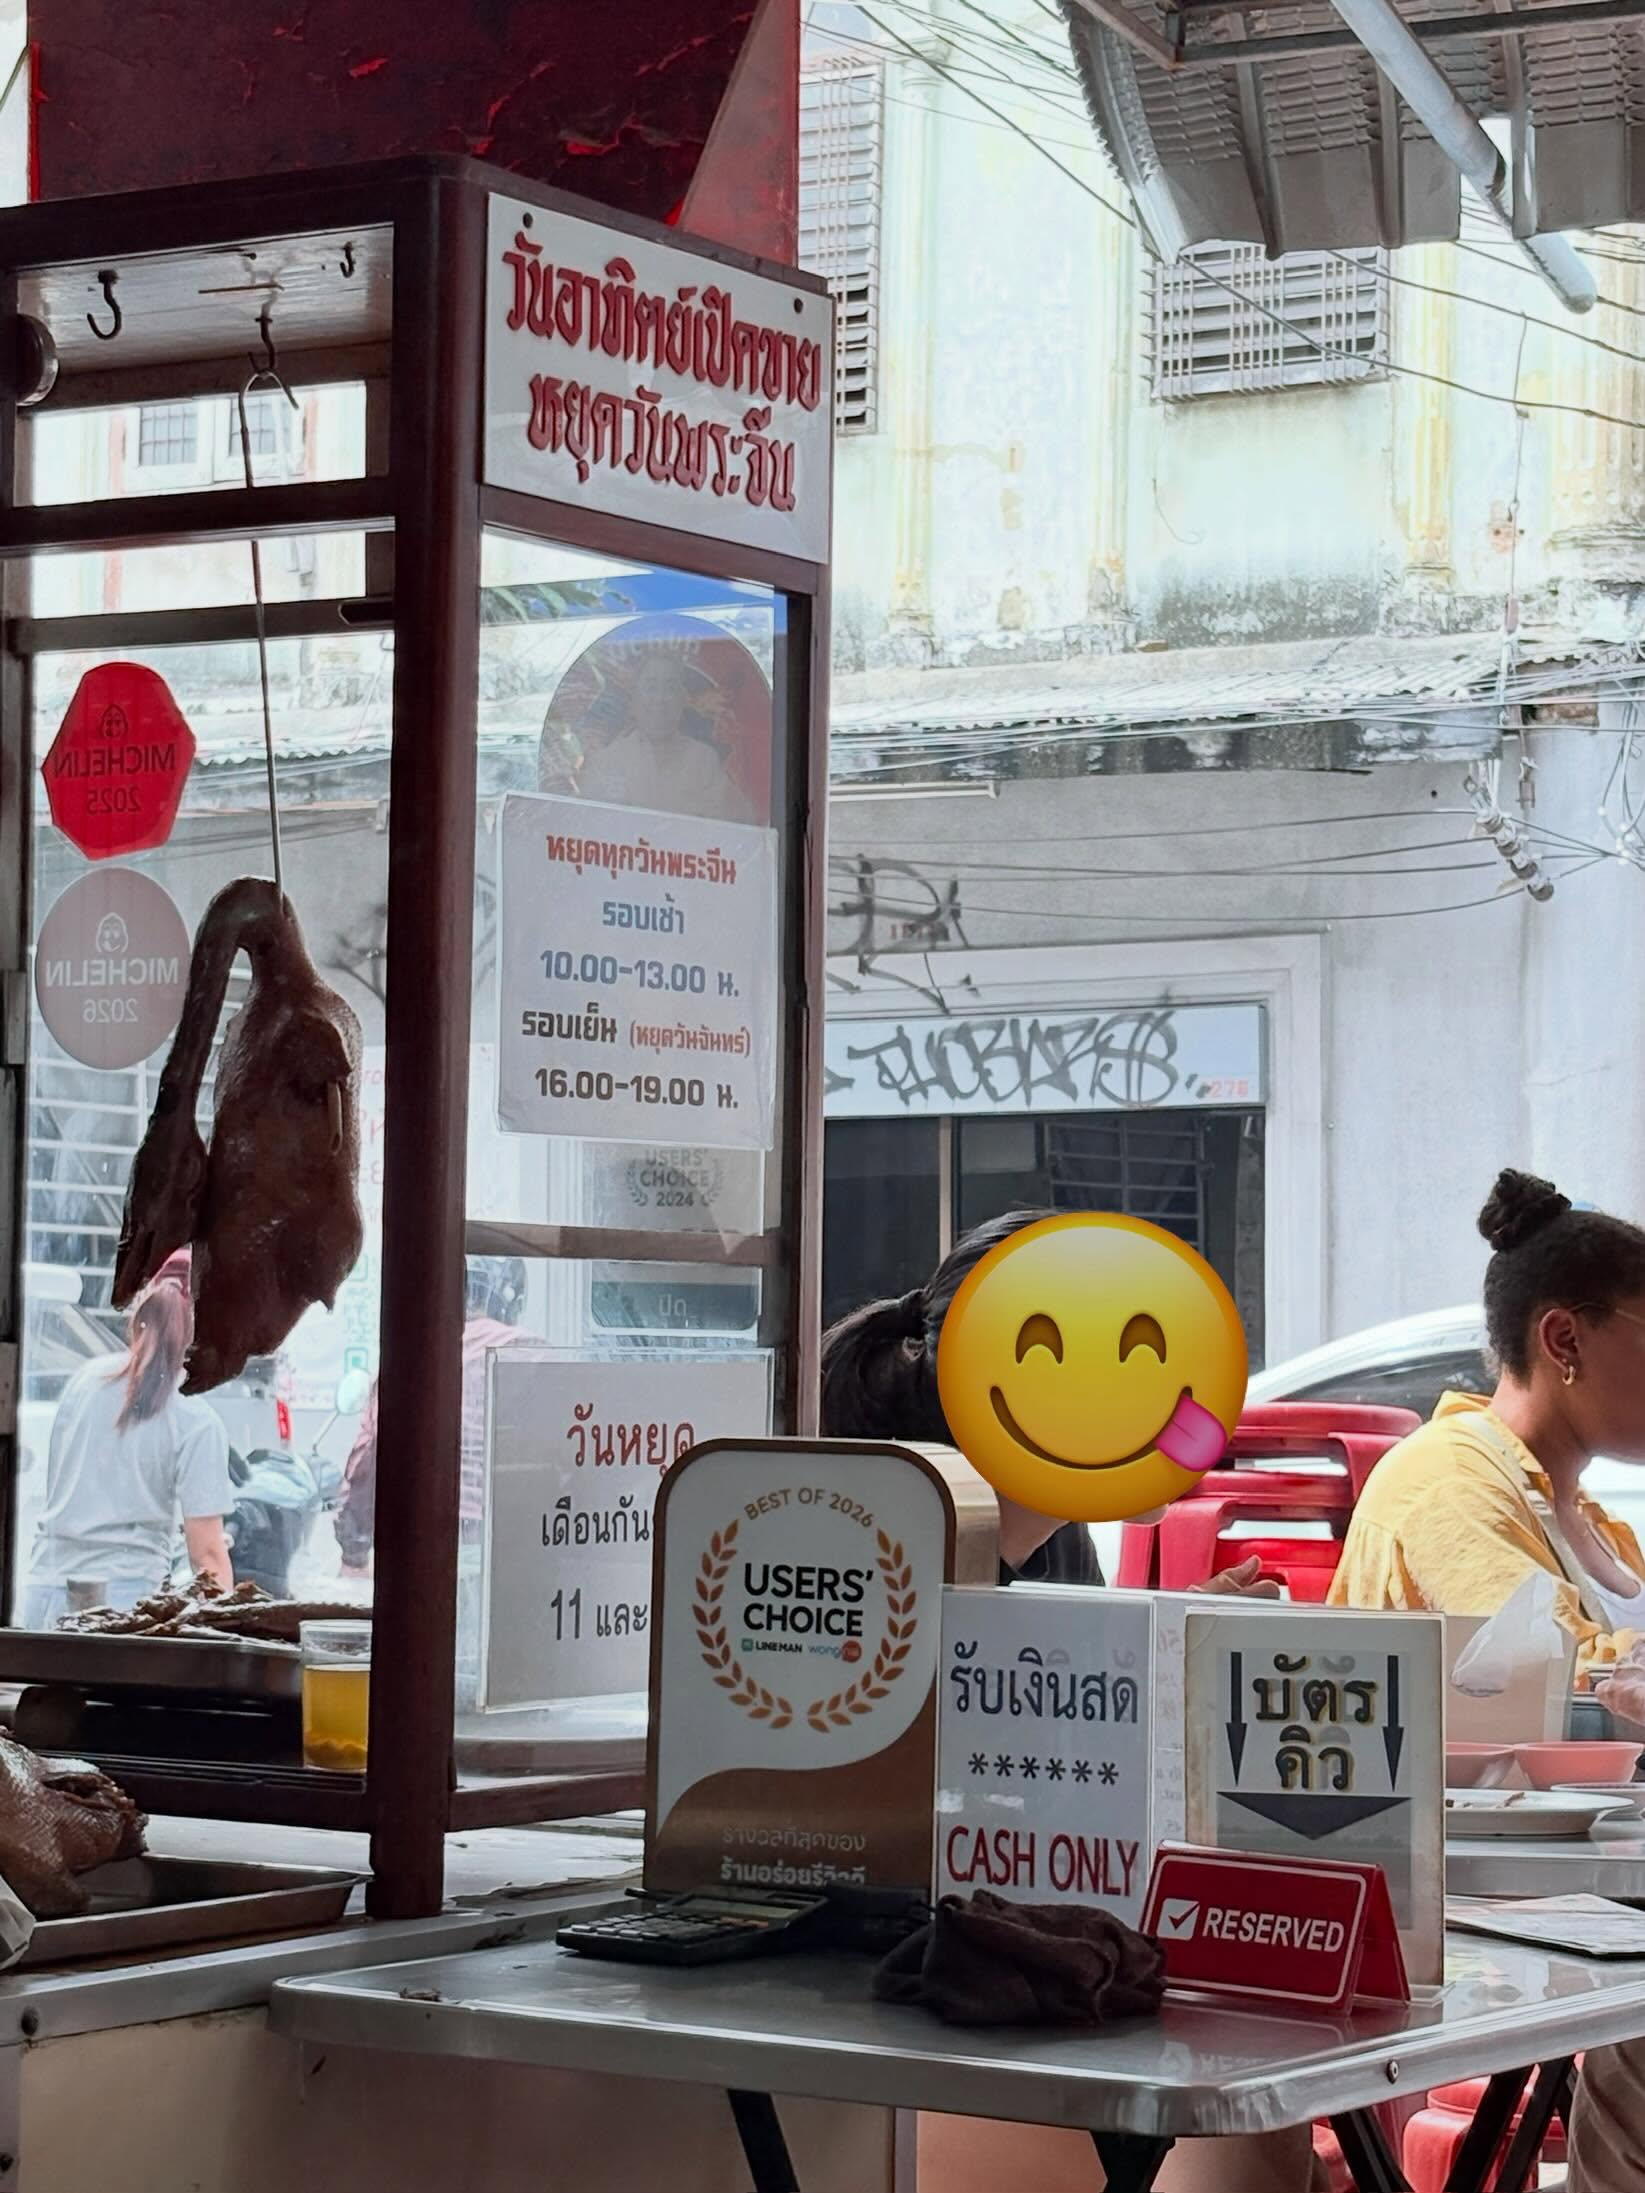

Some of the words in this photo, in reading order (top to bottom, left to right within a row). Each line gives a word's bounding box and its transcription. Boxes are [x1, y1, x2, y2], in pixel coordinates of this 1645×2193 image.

[502, 231, 821, 412] วันอาทิตย์เปิดขาย
[528, 373, 796, 511] หยุดวันพระจีน
[546, 834, 737, 885] หยุดทุกวันพระจีน
[602, 892, 685, 934] รอบเช้า
[540, 950, 706, 994] 10.00-13.00
[717, 971, 740, 997] น.
[522, 1002, 617, 1043] รอบเย็น
[630, 1019, 750, 1058] (หยุดวันจันทร์)
[535, 1067, 705, 1107] 16.00-19.00
[716, 1083, 739, 1109] น.
[639, 1169, 710, 1188] CHOICE
[655, 1191, 695, 1207] 2024
[744, 1488, 791, 1520] BEST
[797, 1486, 826, 1505] OF
[829, 1492, 875, 1528] 2026
[744, 1562, 874, 1603] USERS'
[550, 1588, 581, 1641] 11
[595, 1602, 648, 1637] และ
[743, 1602, 864, 1637] CHOICE
[808, 1642, 861, 1662] wong
[949, 1639, 1139, 1724] รับเงินสด
[1252, 1652, 1377, 1723] บัตร
[1274, 1724, 1352, 1791] คิว
[946, 1825, 1036, 1889] CASH
[1048, 1832, 1140, 1897] ONLY
[1201, 1905, 1345, 1953] RESERVED
